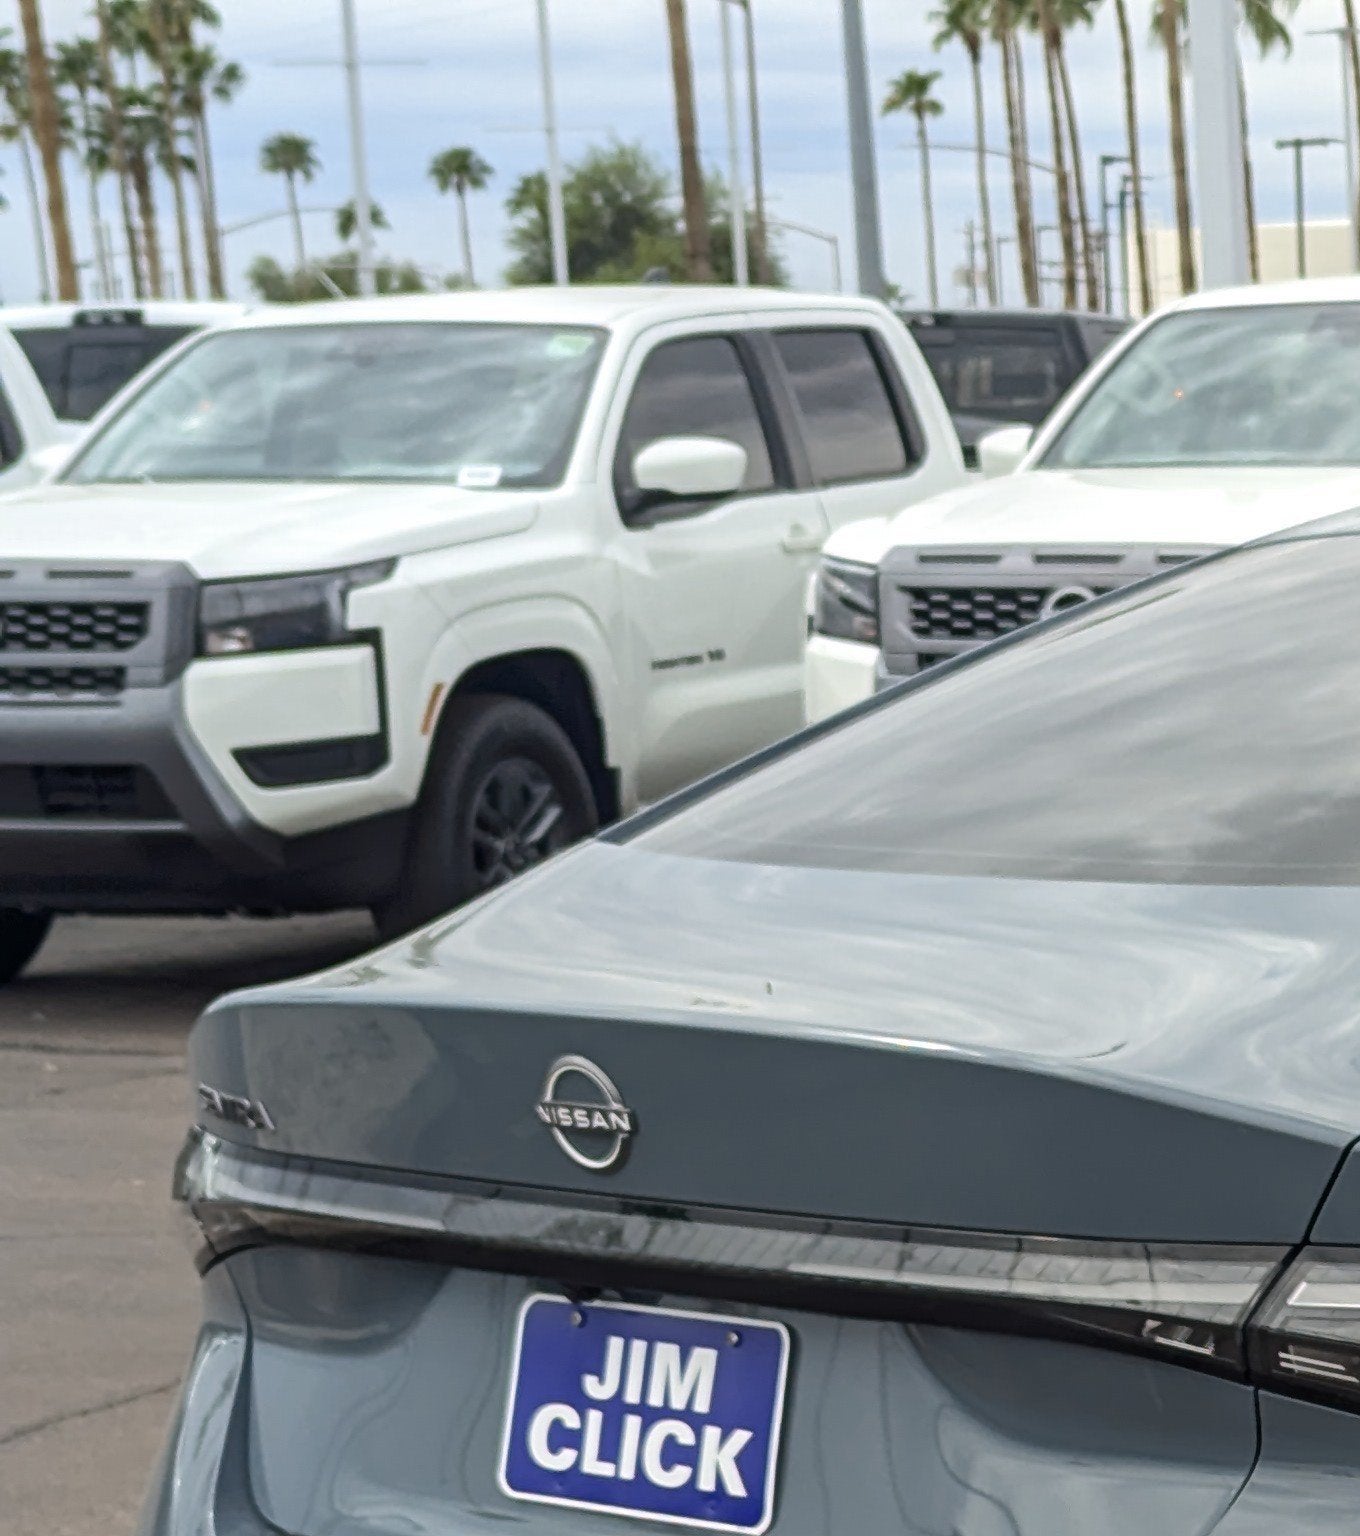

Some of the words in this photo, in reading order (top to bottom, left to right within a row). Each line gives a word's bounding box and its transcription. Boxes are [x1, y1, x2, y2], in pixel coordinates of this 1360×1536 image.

[536, 1104, 631, 1131] NISSAN
[581, 1334, 718, 1414] JIM
[526, 1402, 754, 1499] CLICK
